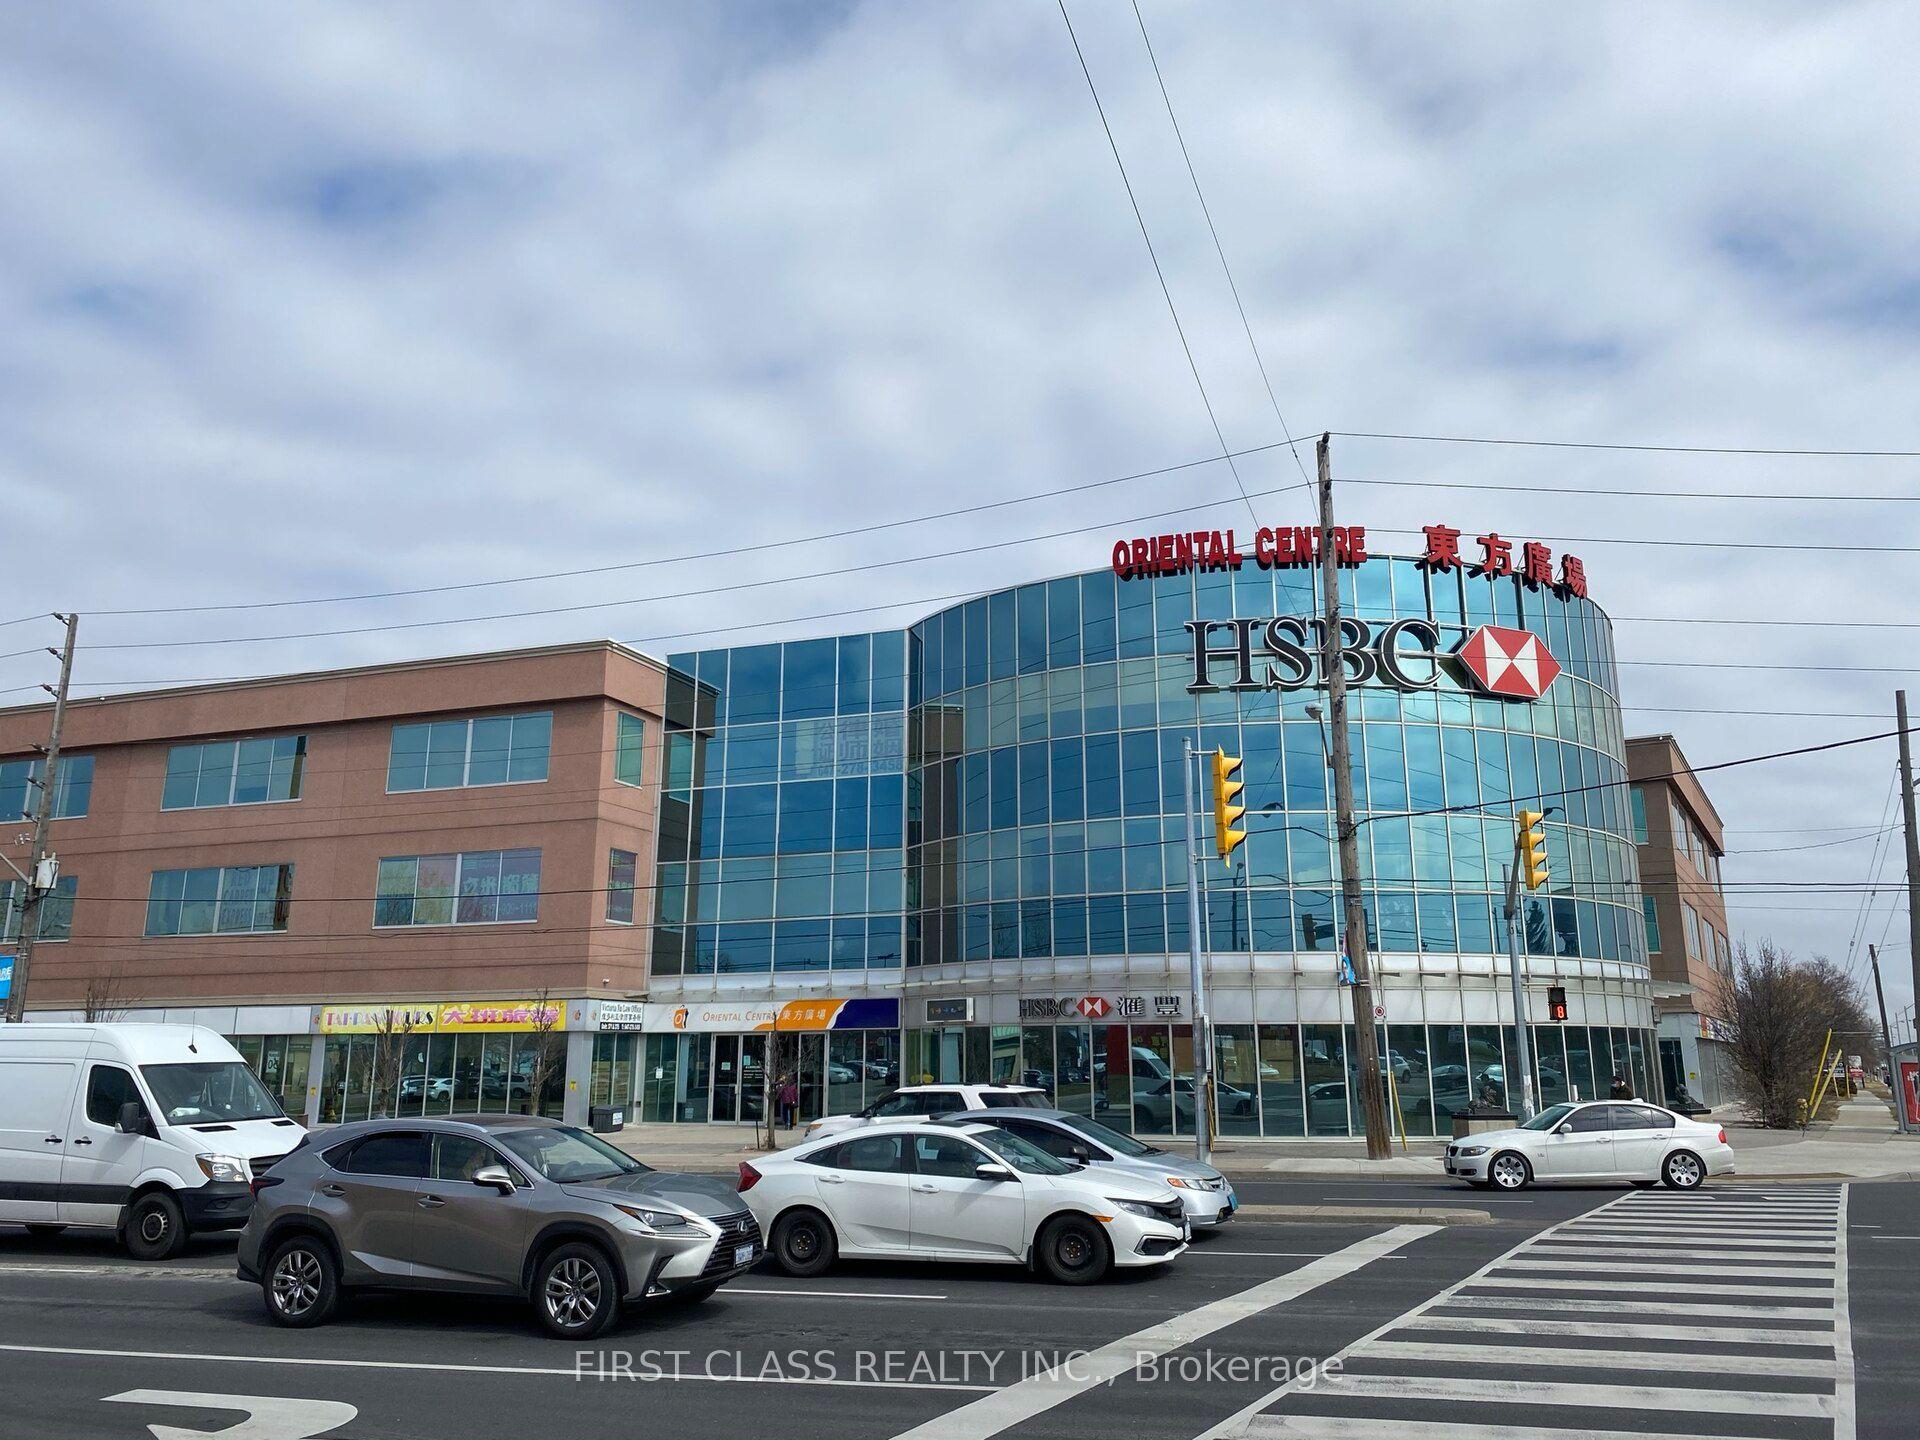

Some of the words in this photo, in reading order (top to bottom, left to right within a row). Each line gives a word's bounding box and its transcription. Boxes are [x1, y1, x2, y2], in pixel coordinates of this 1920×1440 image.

[1112, 529, 1242, 575] ORIENTAL
[1422, 524, 1588, 599] 東方廣場
[1184, 616, 1443, 689] HSBC
[386, 1010, 433, 1025] OURS
[1019, 997, 1076, 1017] HSBC
[1557, 1005, 1564, 1018] 8
